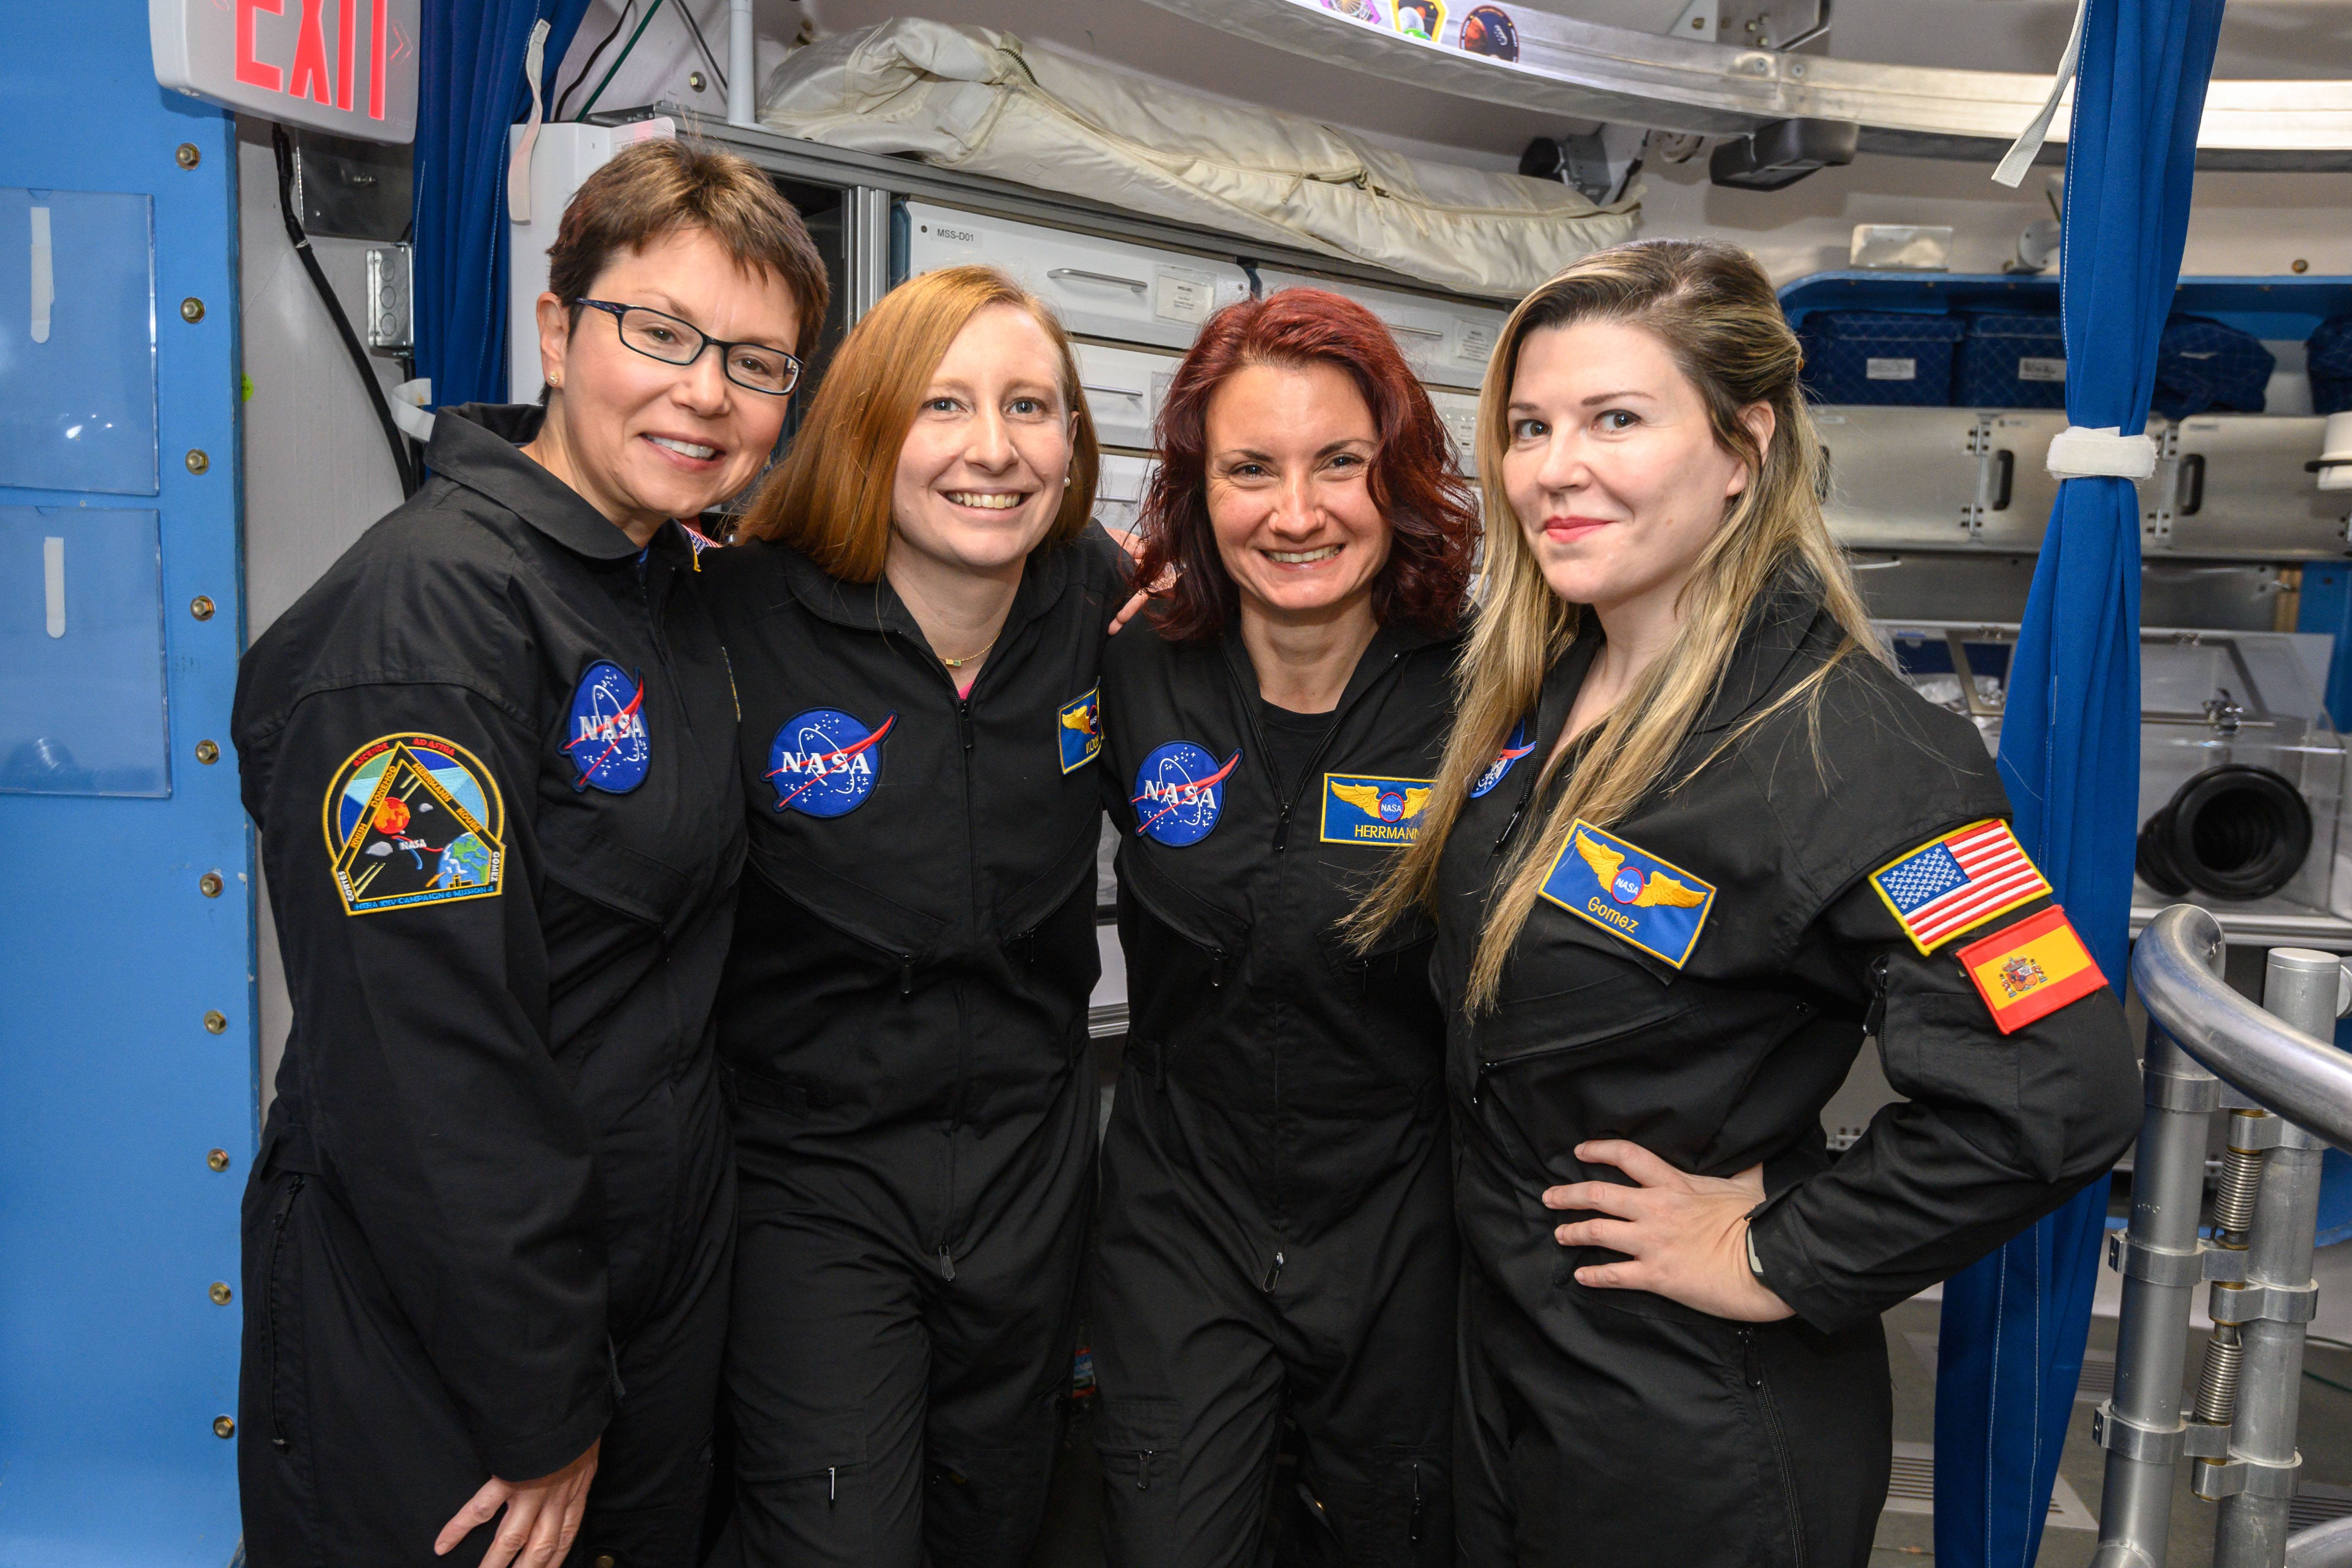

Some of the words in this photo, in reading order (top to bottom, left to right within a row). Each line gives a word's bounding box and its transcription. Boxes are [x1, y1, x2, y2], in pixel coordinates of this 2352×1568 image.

[937, 229, 973, 242] MSS-D01
[579, 714, 646, 741] NASA
[353, 742, 389, 767] ASCENDE
[412, 738, 427, 746] AD
[427, 740, 455, 756] ASTRA
[781, 751, 872, 774] NASA
[370, 765, 396, 808] DONEHOO
[411, 762, 453, 802] HERRMANN
[1143, 780, 1217, 809] NASA
[455, 807, 482, 833] KOUBE
[1381, 804, 1402, 812] NASA
[349, 823, 368, 849] KNISH
[398, 838, 427, 851] NASA
[490, 851, 501, 882] GOMEZ
[338, 871, 354, 902] CORTES
[354, 901, 378, 910] HERA
[378, 899, 396, 907] XXV
[398, 892, 444, 904] CAMPAIGN
[454, 886, 487, 896] MISSION
[1615, 877, 1639, 895] NASA
[1587, 896, 1639, 934] Gomez
